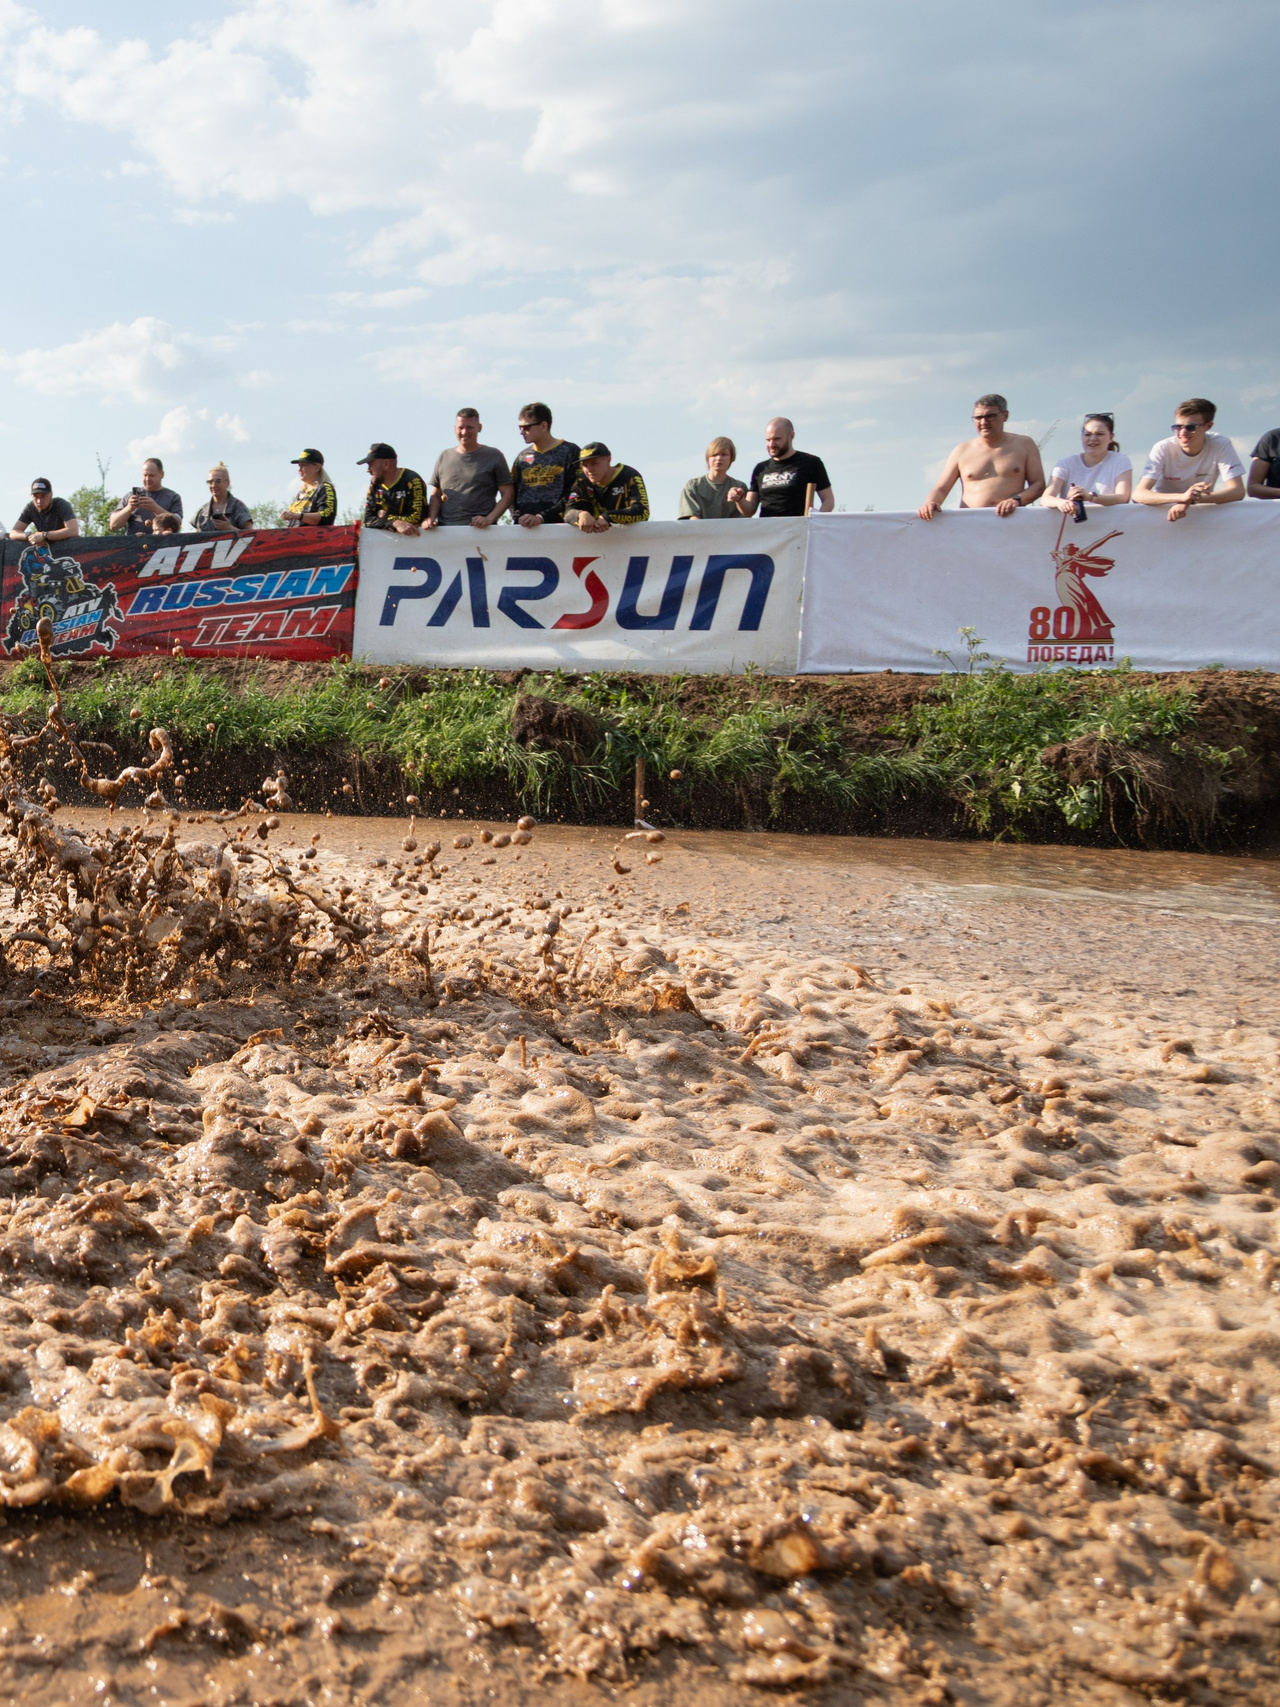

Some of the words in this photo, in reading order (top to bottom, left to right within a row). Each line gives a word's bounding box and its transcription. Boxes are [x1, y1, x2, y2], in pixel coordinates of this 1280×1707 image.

[138, 537, 255, 578] ATV
[61, 596, 103, 619] ATV
[126, 563, 356, 616] RUSSIAN
[192, 604, 342, 646] TEAM
[1029, 606, 1075, 640] 80
[1027, 646, 1114, 664] ПОБЕДА!
